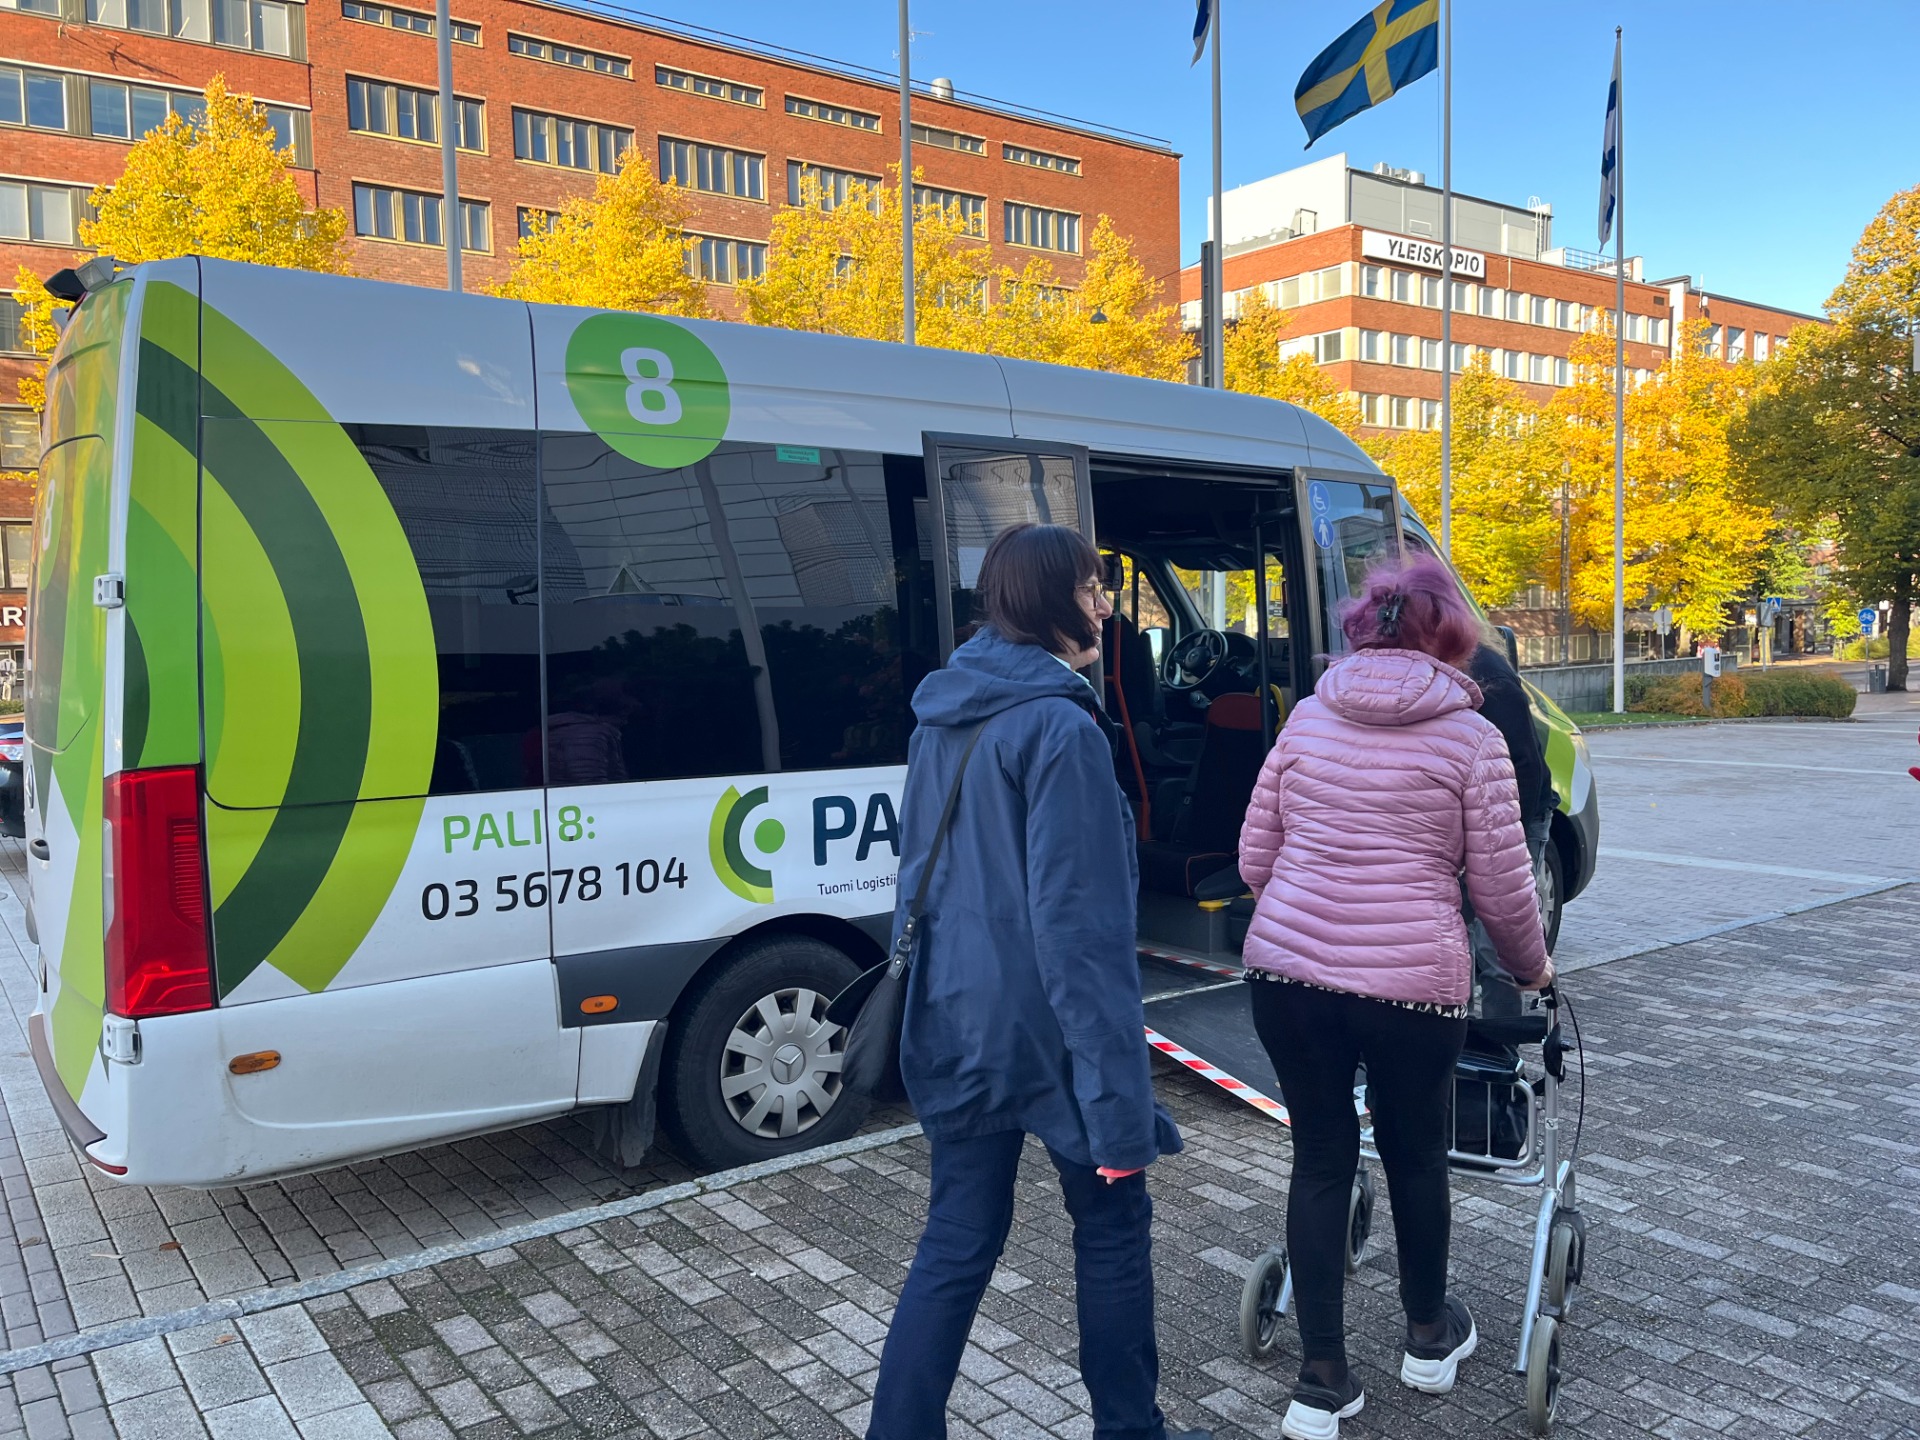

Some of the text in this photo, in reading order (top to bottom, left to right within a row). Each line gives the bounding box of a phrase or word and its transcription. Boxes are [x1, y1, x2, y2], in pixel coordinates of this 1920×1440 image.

[620, 347, 683, 425] 8
[443, 805, 595, 854] PALI 8:
[812, 792, 901, 866] PA
[421, 856, 688, 921] 03 5678 104
[817, 873, 897, 896] Tuomi Logistii
